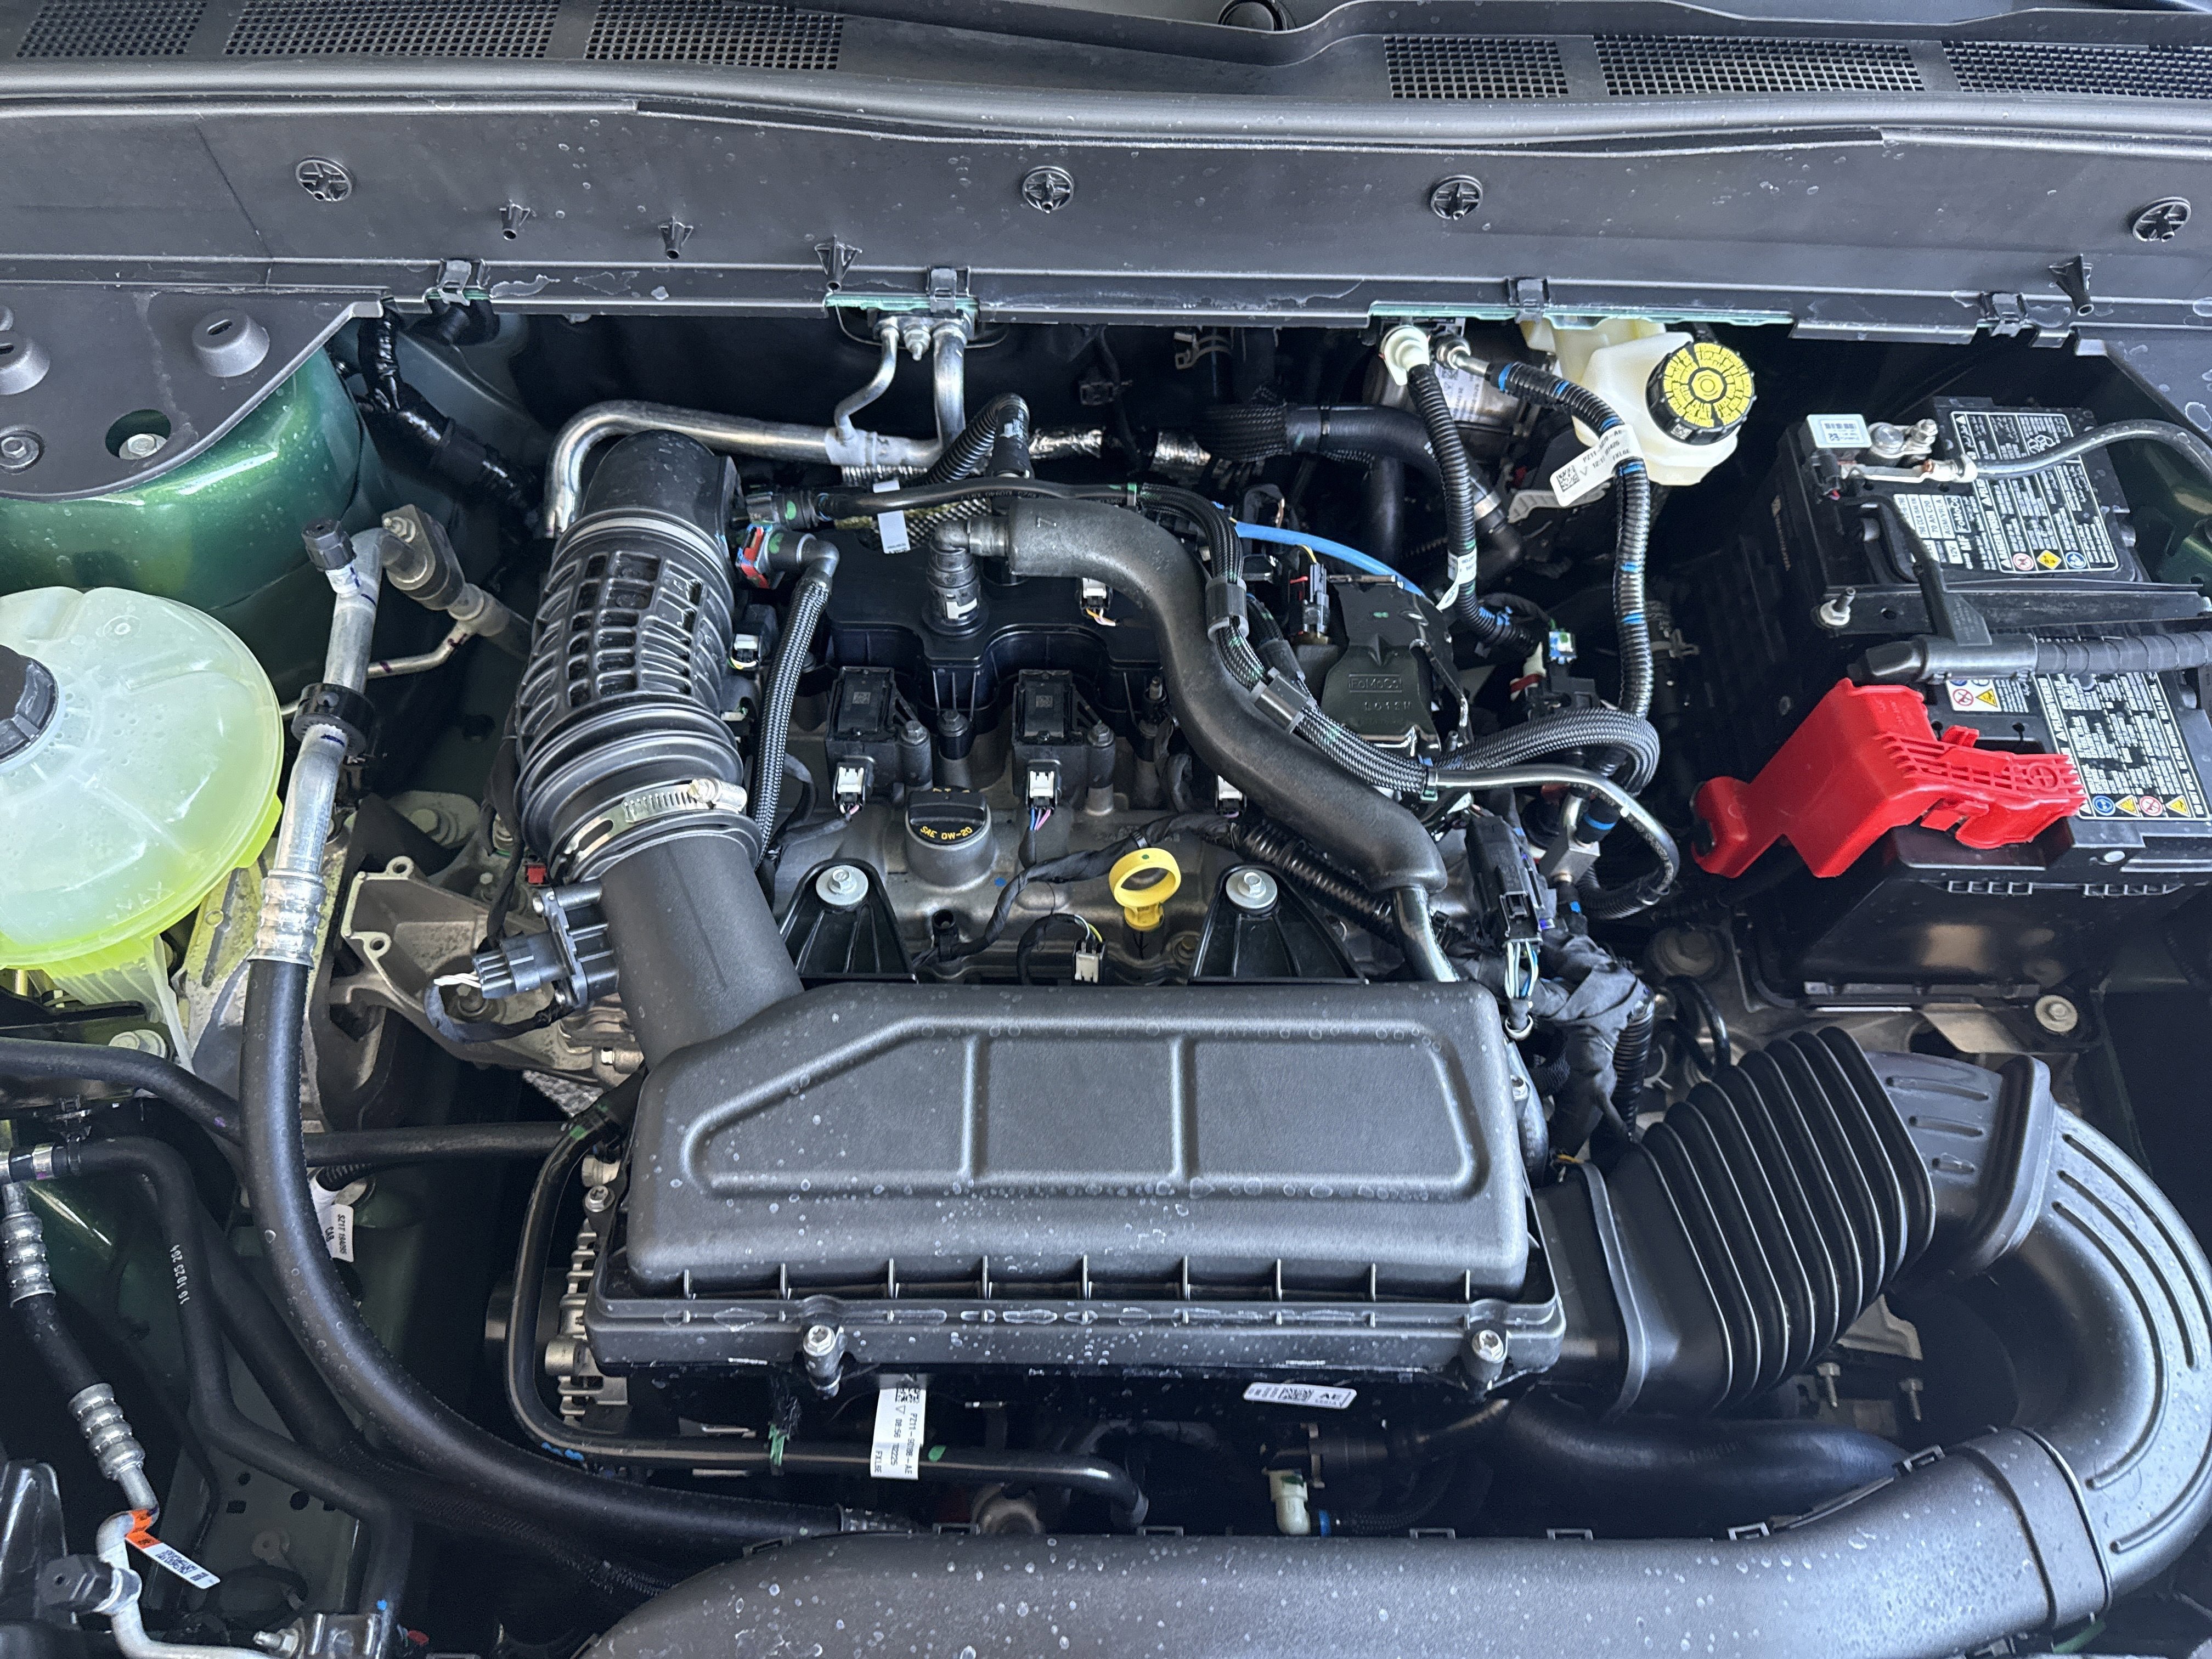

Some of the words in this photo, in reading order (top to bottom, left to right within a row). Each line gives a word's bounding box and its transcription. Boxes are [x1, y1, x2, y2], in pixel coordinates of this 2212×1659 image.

[1923, 500, 1933, 512] C20
[1937, 500, 1951, 535] AGM/VRLA
[1951, 497, 1967, 531] FoMoCo
[1956, 534, 1972, 550] MF
[1949, 546, 1959, 557] 12V
[1351, 677, 1399, 689] FoMoCo
[920, 826, 938, 838] SAE
[325, 1226, 334, 1243] CAB
[173, 1264, 188, 1289] 1025
[178, 1290, 190, 1305] 16
